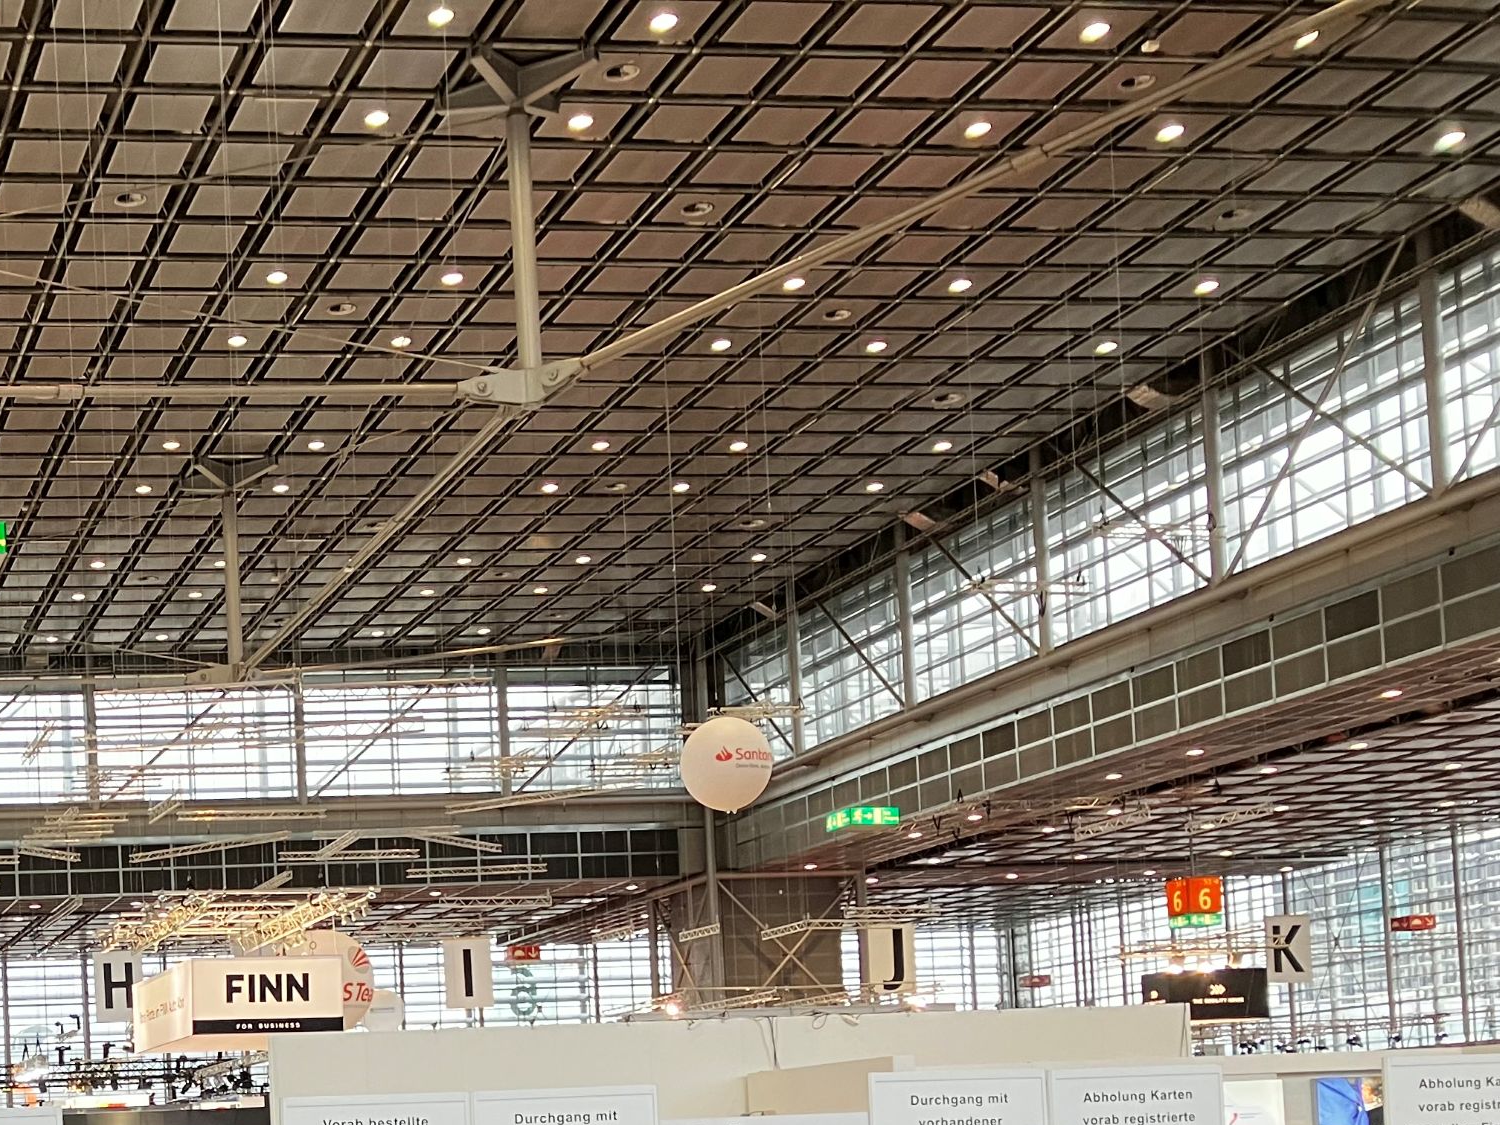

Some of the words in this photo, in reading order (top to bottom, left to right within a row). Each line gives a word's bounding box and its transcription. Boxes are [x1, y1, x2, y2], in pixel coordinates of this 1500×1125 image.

[1173, 890, 1182, 912] 6
[1199, 888, 1212, 910] 6
[1272, 924, 1305, 973] K
[883, 928, 905, 991] J
[463, 949, 474, 997] I
[102, 962, 134, 1009] H
[225, 972, 310, 1004] FINN
[257, 1021, 301, 1031] BUSINESS
[1418, 1077, 1482, 1090] Abholung
[910, 1094, 983, 1108] Durchgang
[988, 1092, 1009, 1104] mit
[1083, 1091, 1146, 1104] Abholung
[1150, 1089, 1193, 1100] Karten
[595, 1110, 618, 1122] mit
[1418, 1101, 1456, 1112] vorab
[1083, 1114, 1120, 1125] vorab
[1124, 1112, 1196, 1125] registrierte
